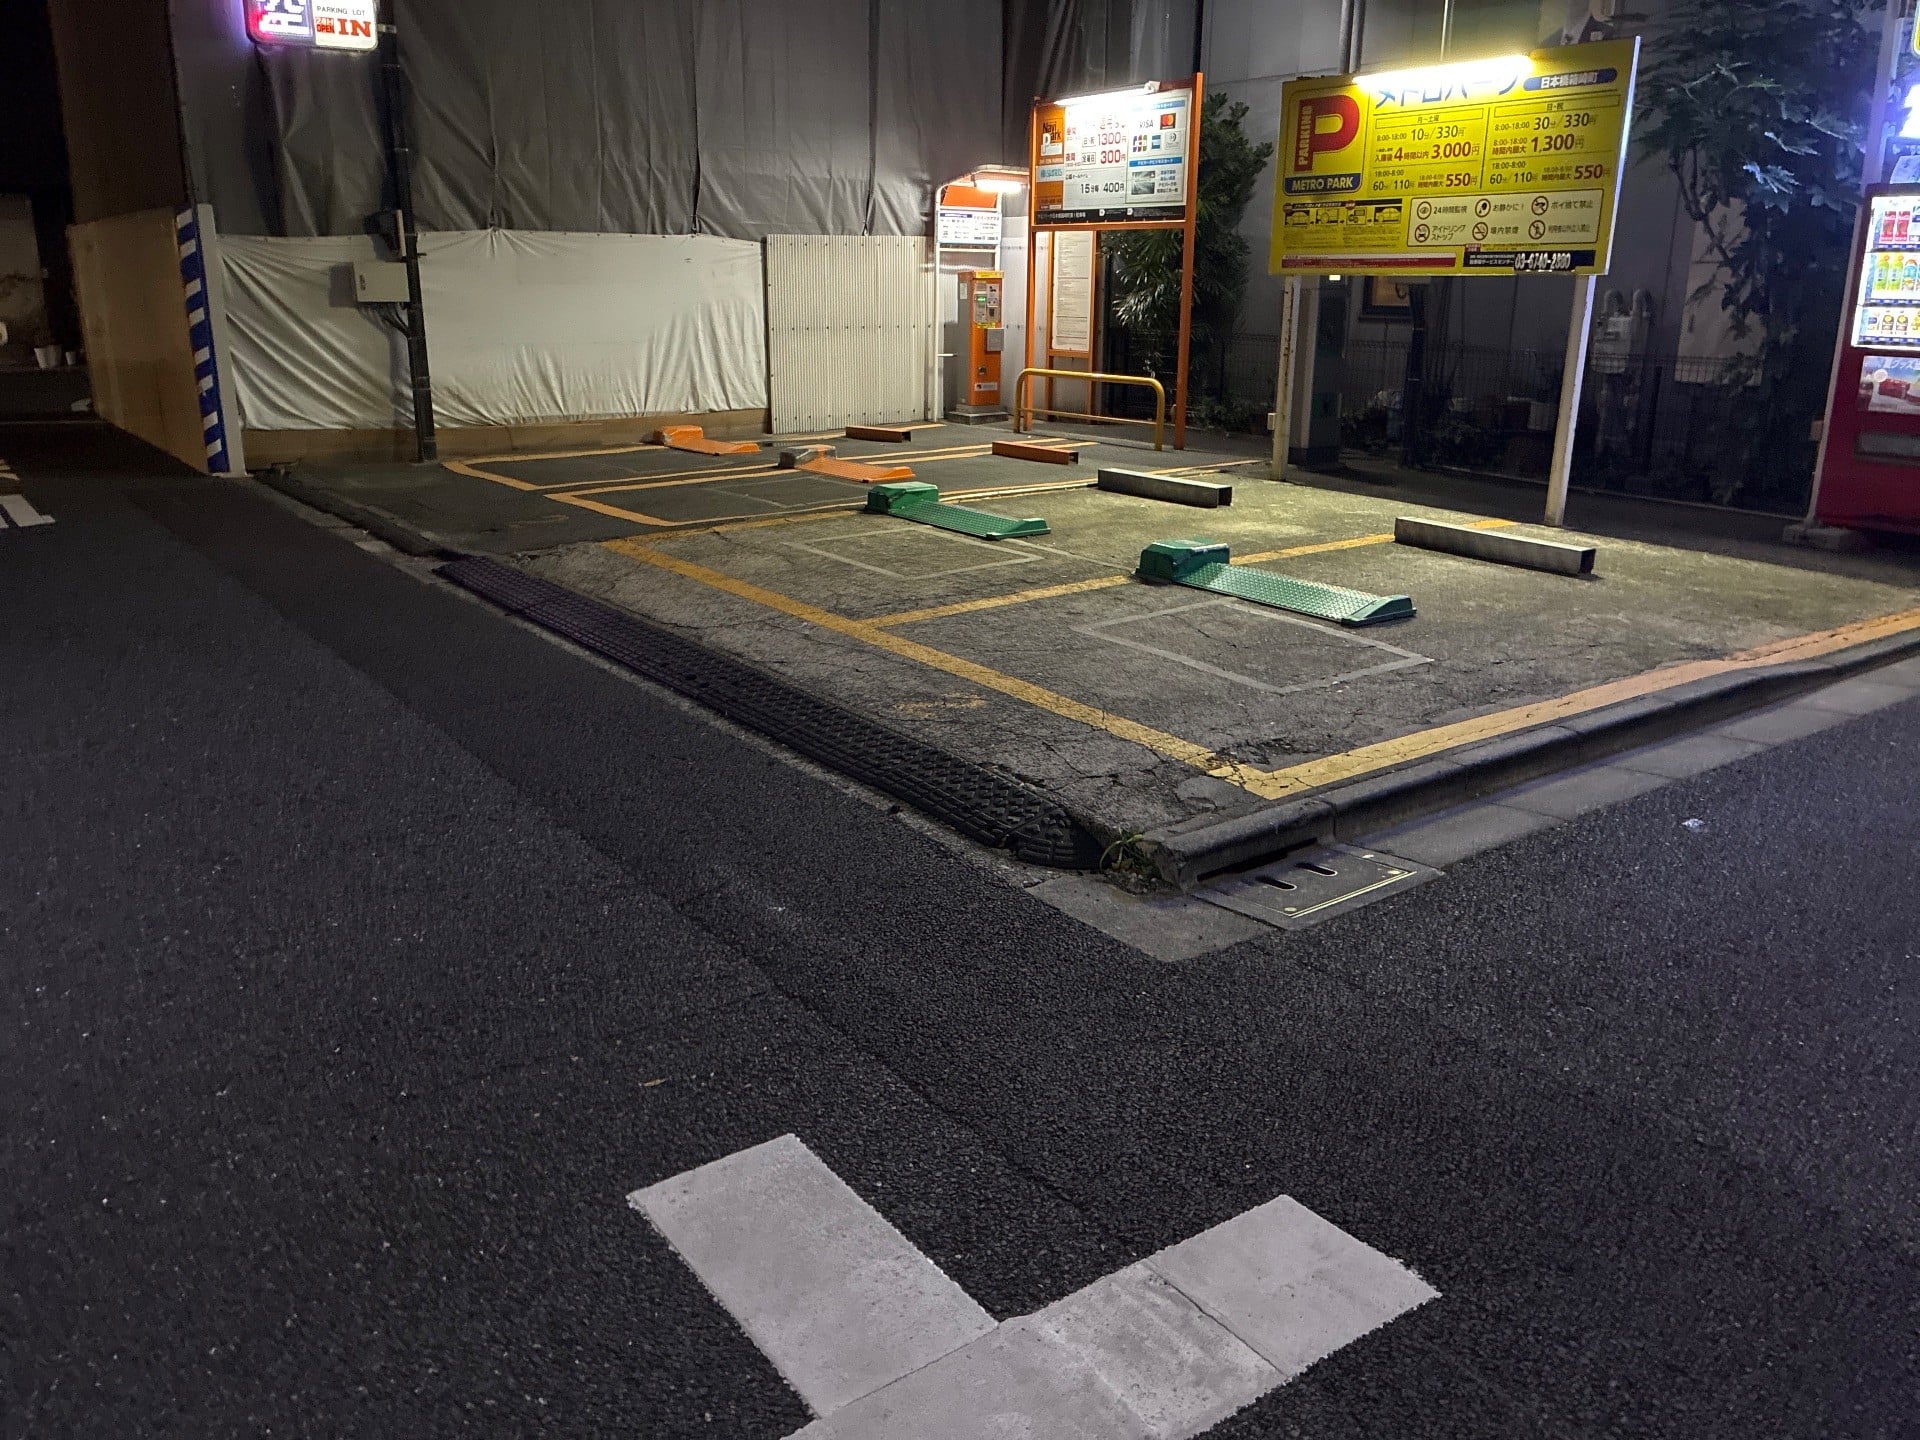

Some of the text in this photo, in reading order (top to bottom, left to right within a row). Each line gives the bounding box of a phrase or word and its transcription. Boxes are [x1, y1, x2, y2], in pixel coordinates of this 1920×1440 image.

[316, 5, 348, 15] PARKING
[316, 24, 335, 33] OPEN
[337, 18, 372, 37] IN
[1139, 119, 1154, 129] VISA
[1298, 105, 1313, 166] PARKING
[1291, 177, 1354, 191] METRO PARK
[1432, 224, 1467, 233] アイドリング
[1431, 233, 1454, 241] ストップ
